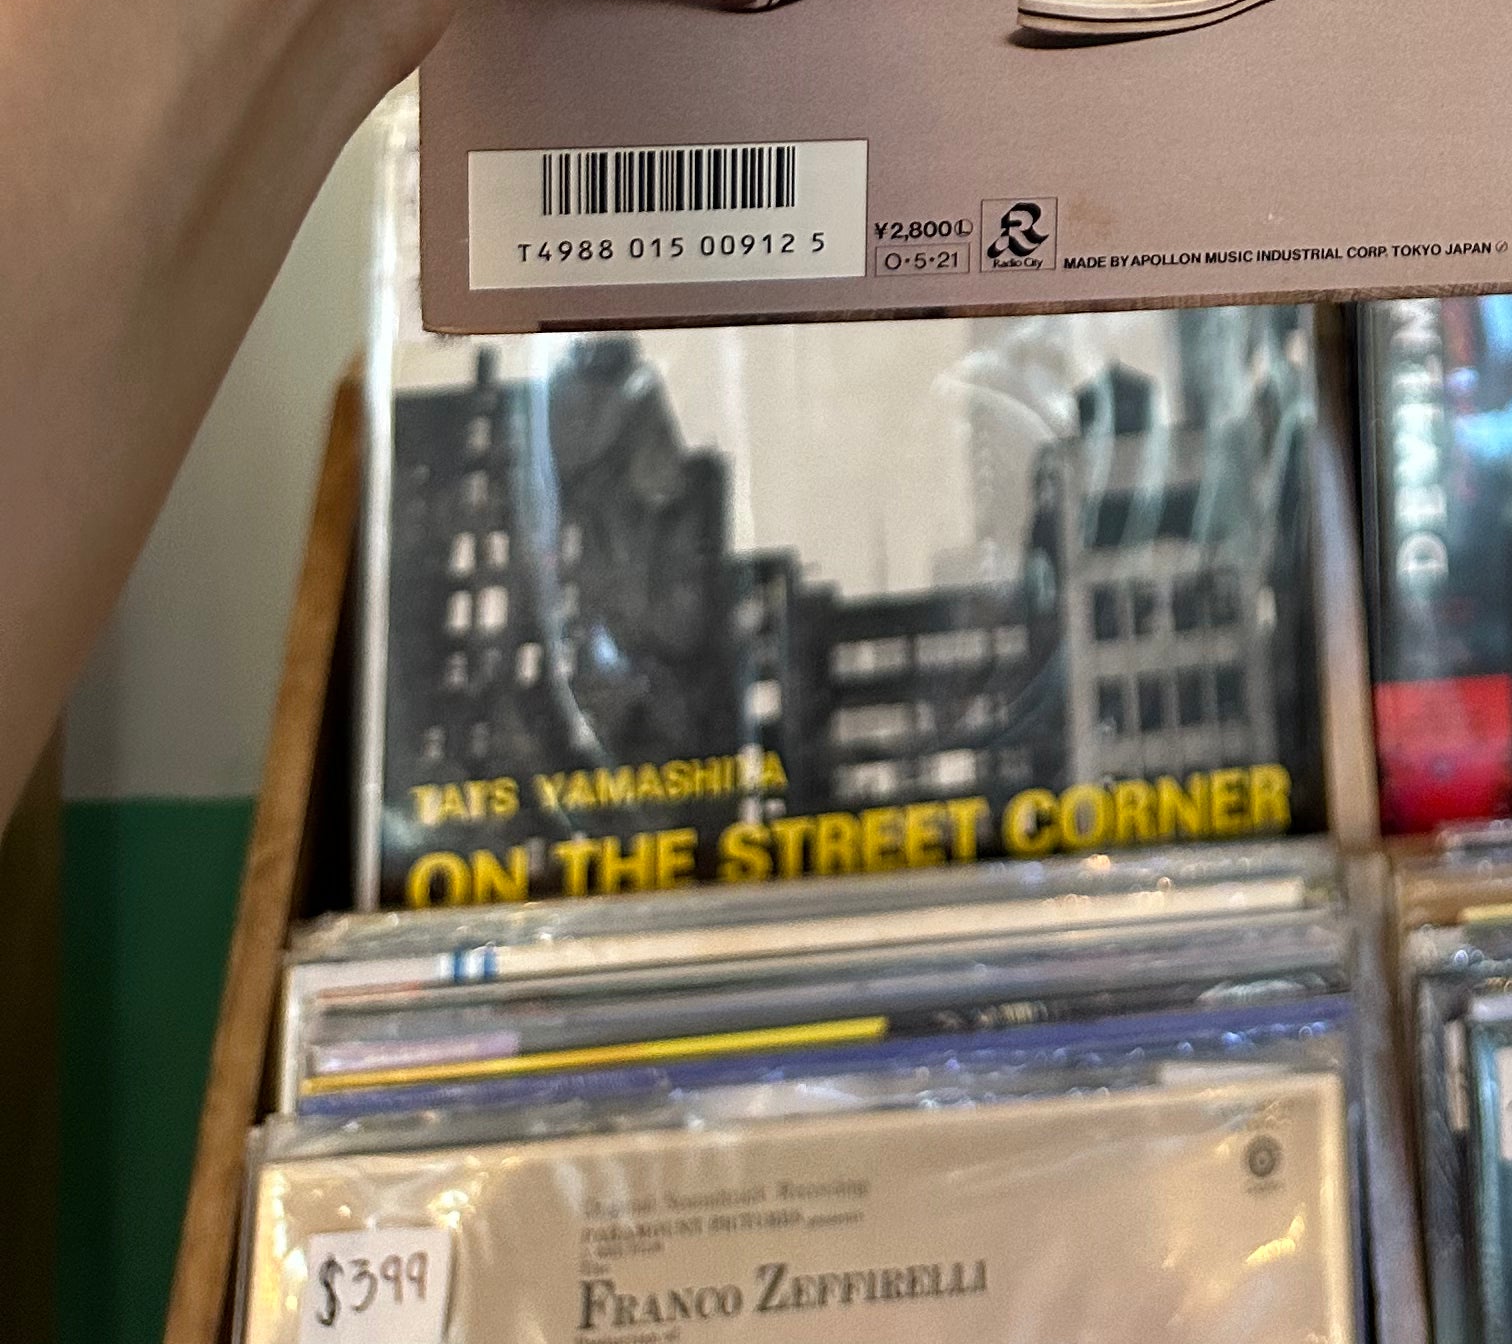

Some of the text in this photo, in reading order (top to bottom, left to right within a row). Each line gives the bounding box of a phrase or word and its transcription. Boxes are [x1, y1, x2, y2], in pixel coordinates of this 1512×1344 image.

[517, 239, 613, 263] T4988
[628, 237, 684, 260] 015
[698, 233, 795, 258] 00912
[1063, 256, 1106, 270] MADE
[1110, 255, 1129, 268] BY
[1130, 253, 1201, 268] APOLLON
[1205, 250, 1253, 264] MUSIC
[1256, 248, 1343, 262] INDUSTRIAL
[1391, 243, 1442, 258] TOKYO
[1445, 242, 1491, 256] JAPAN
[411, 749, 791, 827] TATS YAMASHITA
[407, 763, 1293, 909] ON THE STREET CORNER
[576, 1258, 988, 1332] FRANCO ZEFFIRELLI
